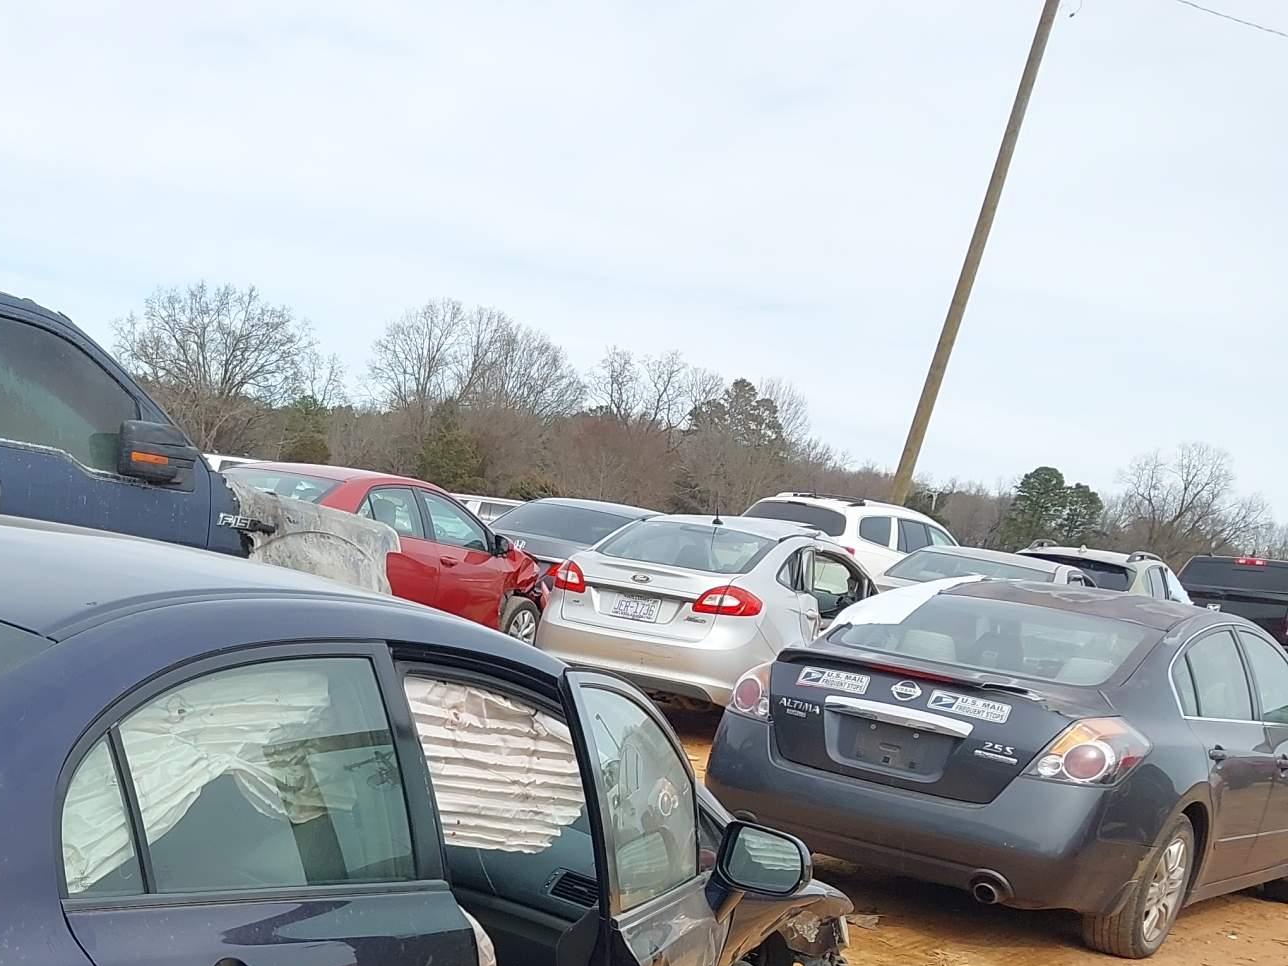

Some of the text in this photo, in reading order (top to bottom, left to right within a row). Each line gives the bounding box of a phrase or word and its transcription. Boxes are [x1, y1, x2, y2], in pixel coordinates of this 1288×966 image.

[845, 674, 865, 684] MAIL
[778, 697, 821, 715] ALTIMA
[955, 704, 1005, 721] FREQUENT STOPS
[961, 697, 1005, 713] U.S. MAIL
